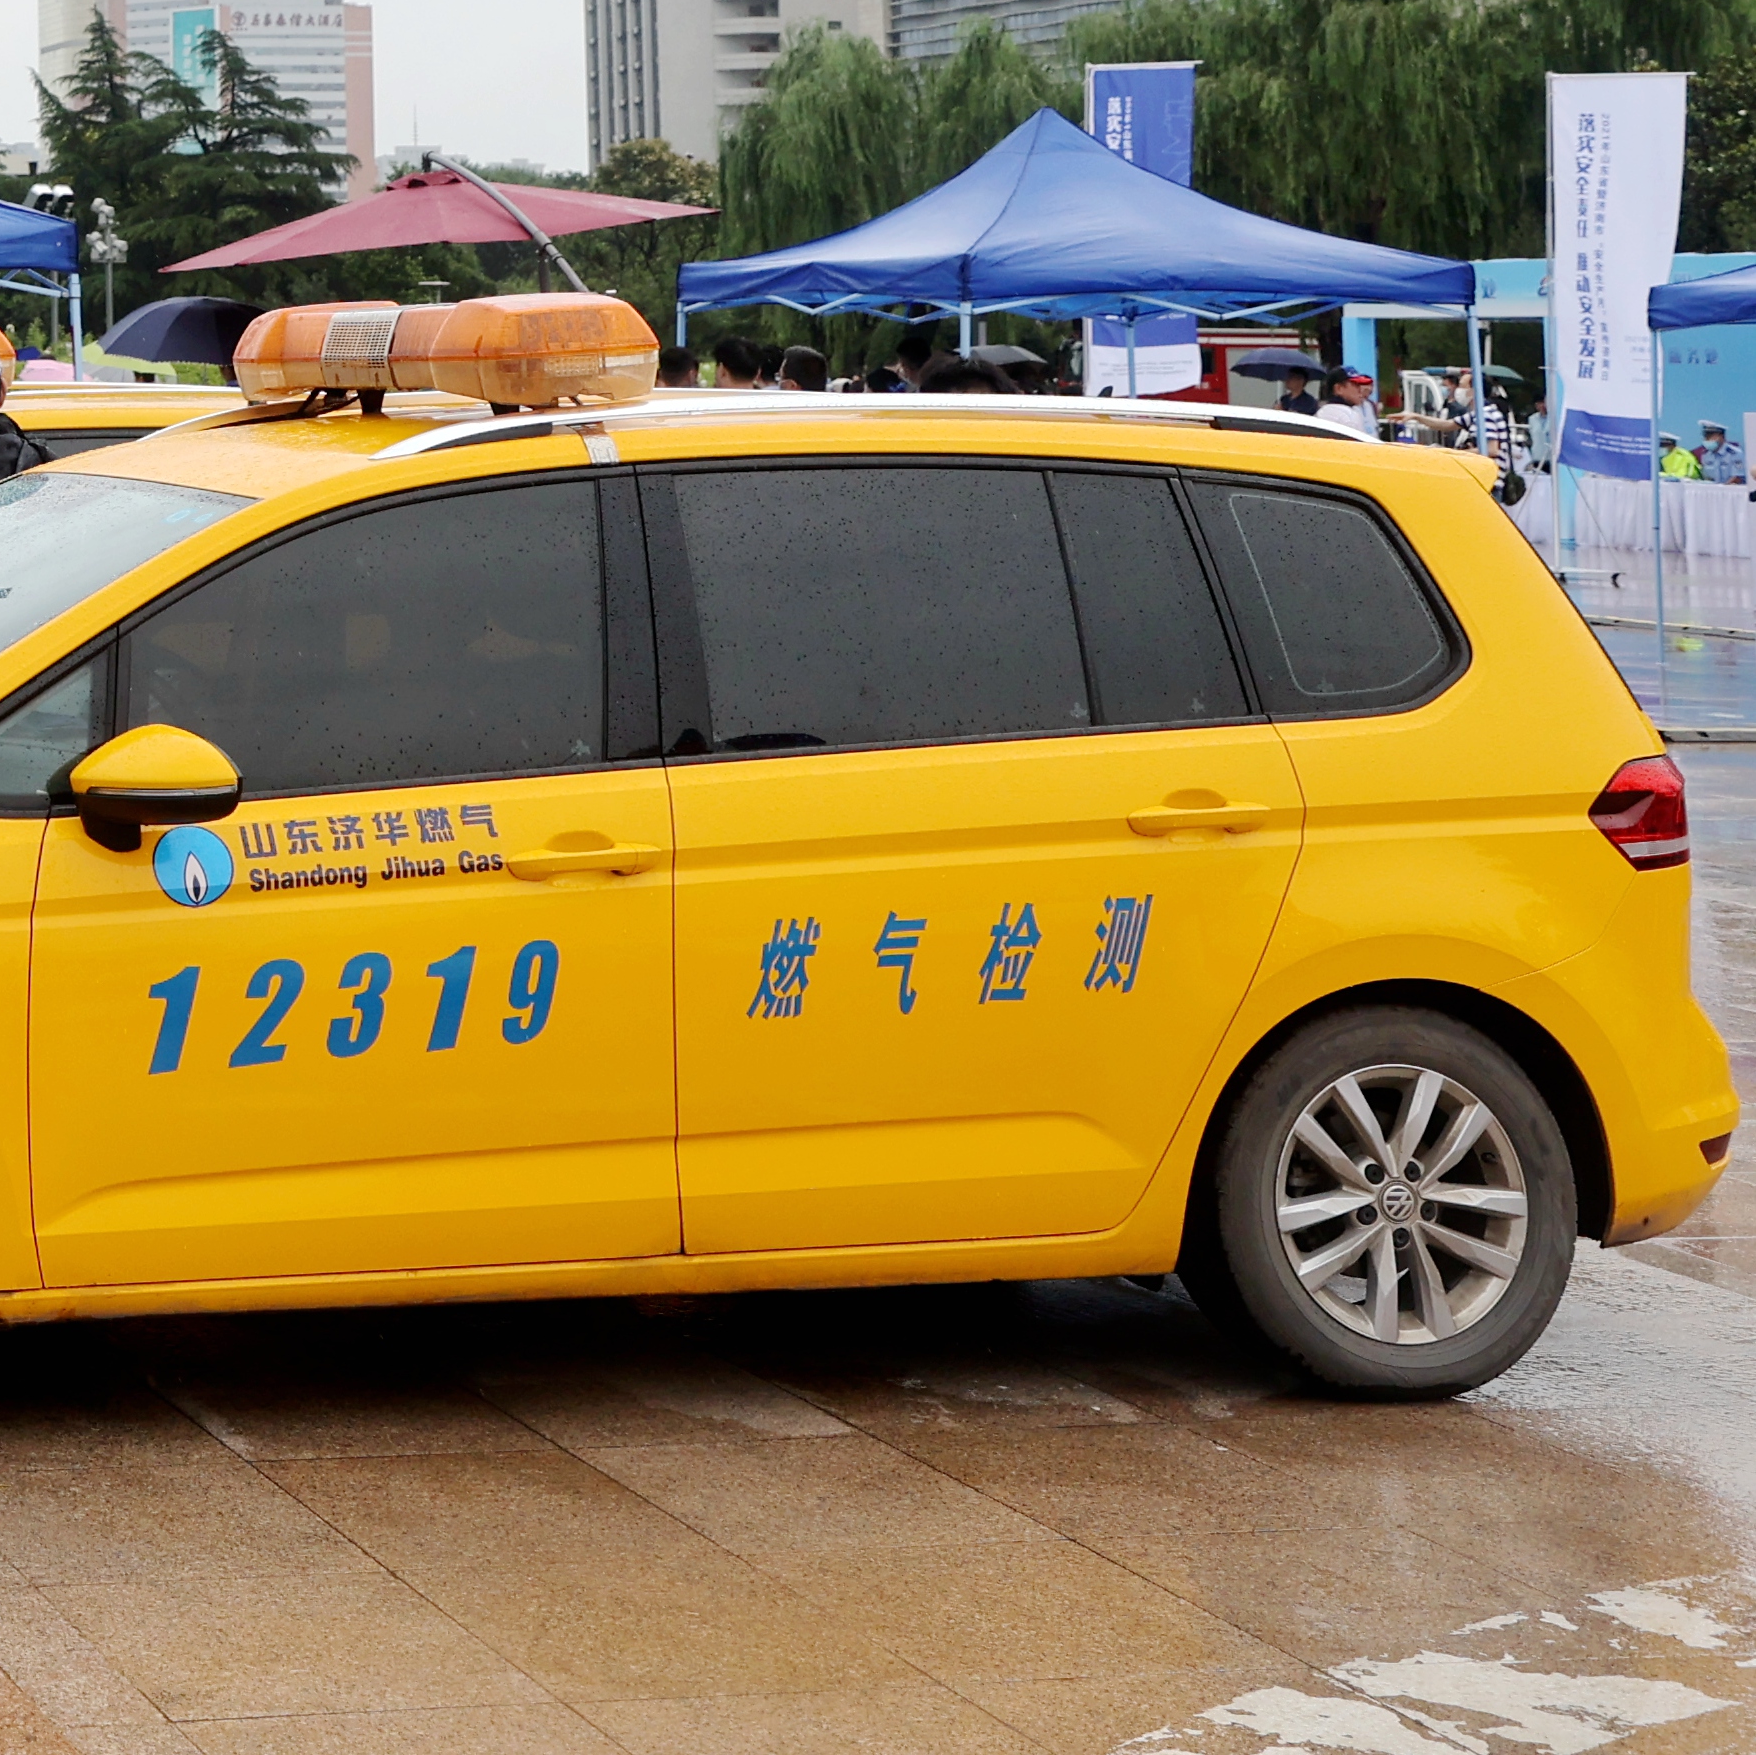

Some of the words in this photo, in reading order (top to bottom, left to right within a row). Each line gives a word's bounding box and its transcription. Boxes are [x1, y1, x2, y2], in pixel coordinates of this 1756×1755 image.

[1576, 113, 1596, 238] 落实安全责任
[239, 804, 499, 861] 山东济华燃气
[249, 859, 368, 893] Shandong
[381, 854, 445, 881] Jihua
[459, 850, 504, 874] Gas
[147, 939, 561, 1076] 12319
[746, 894, 1154, 1020] 燃气检测
